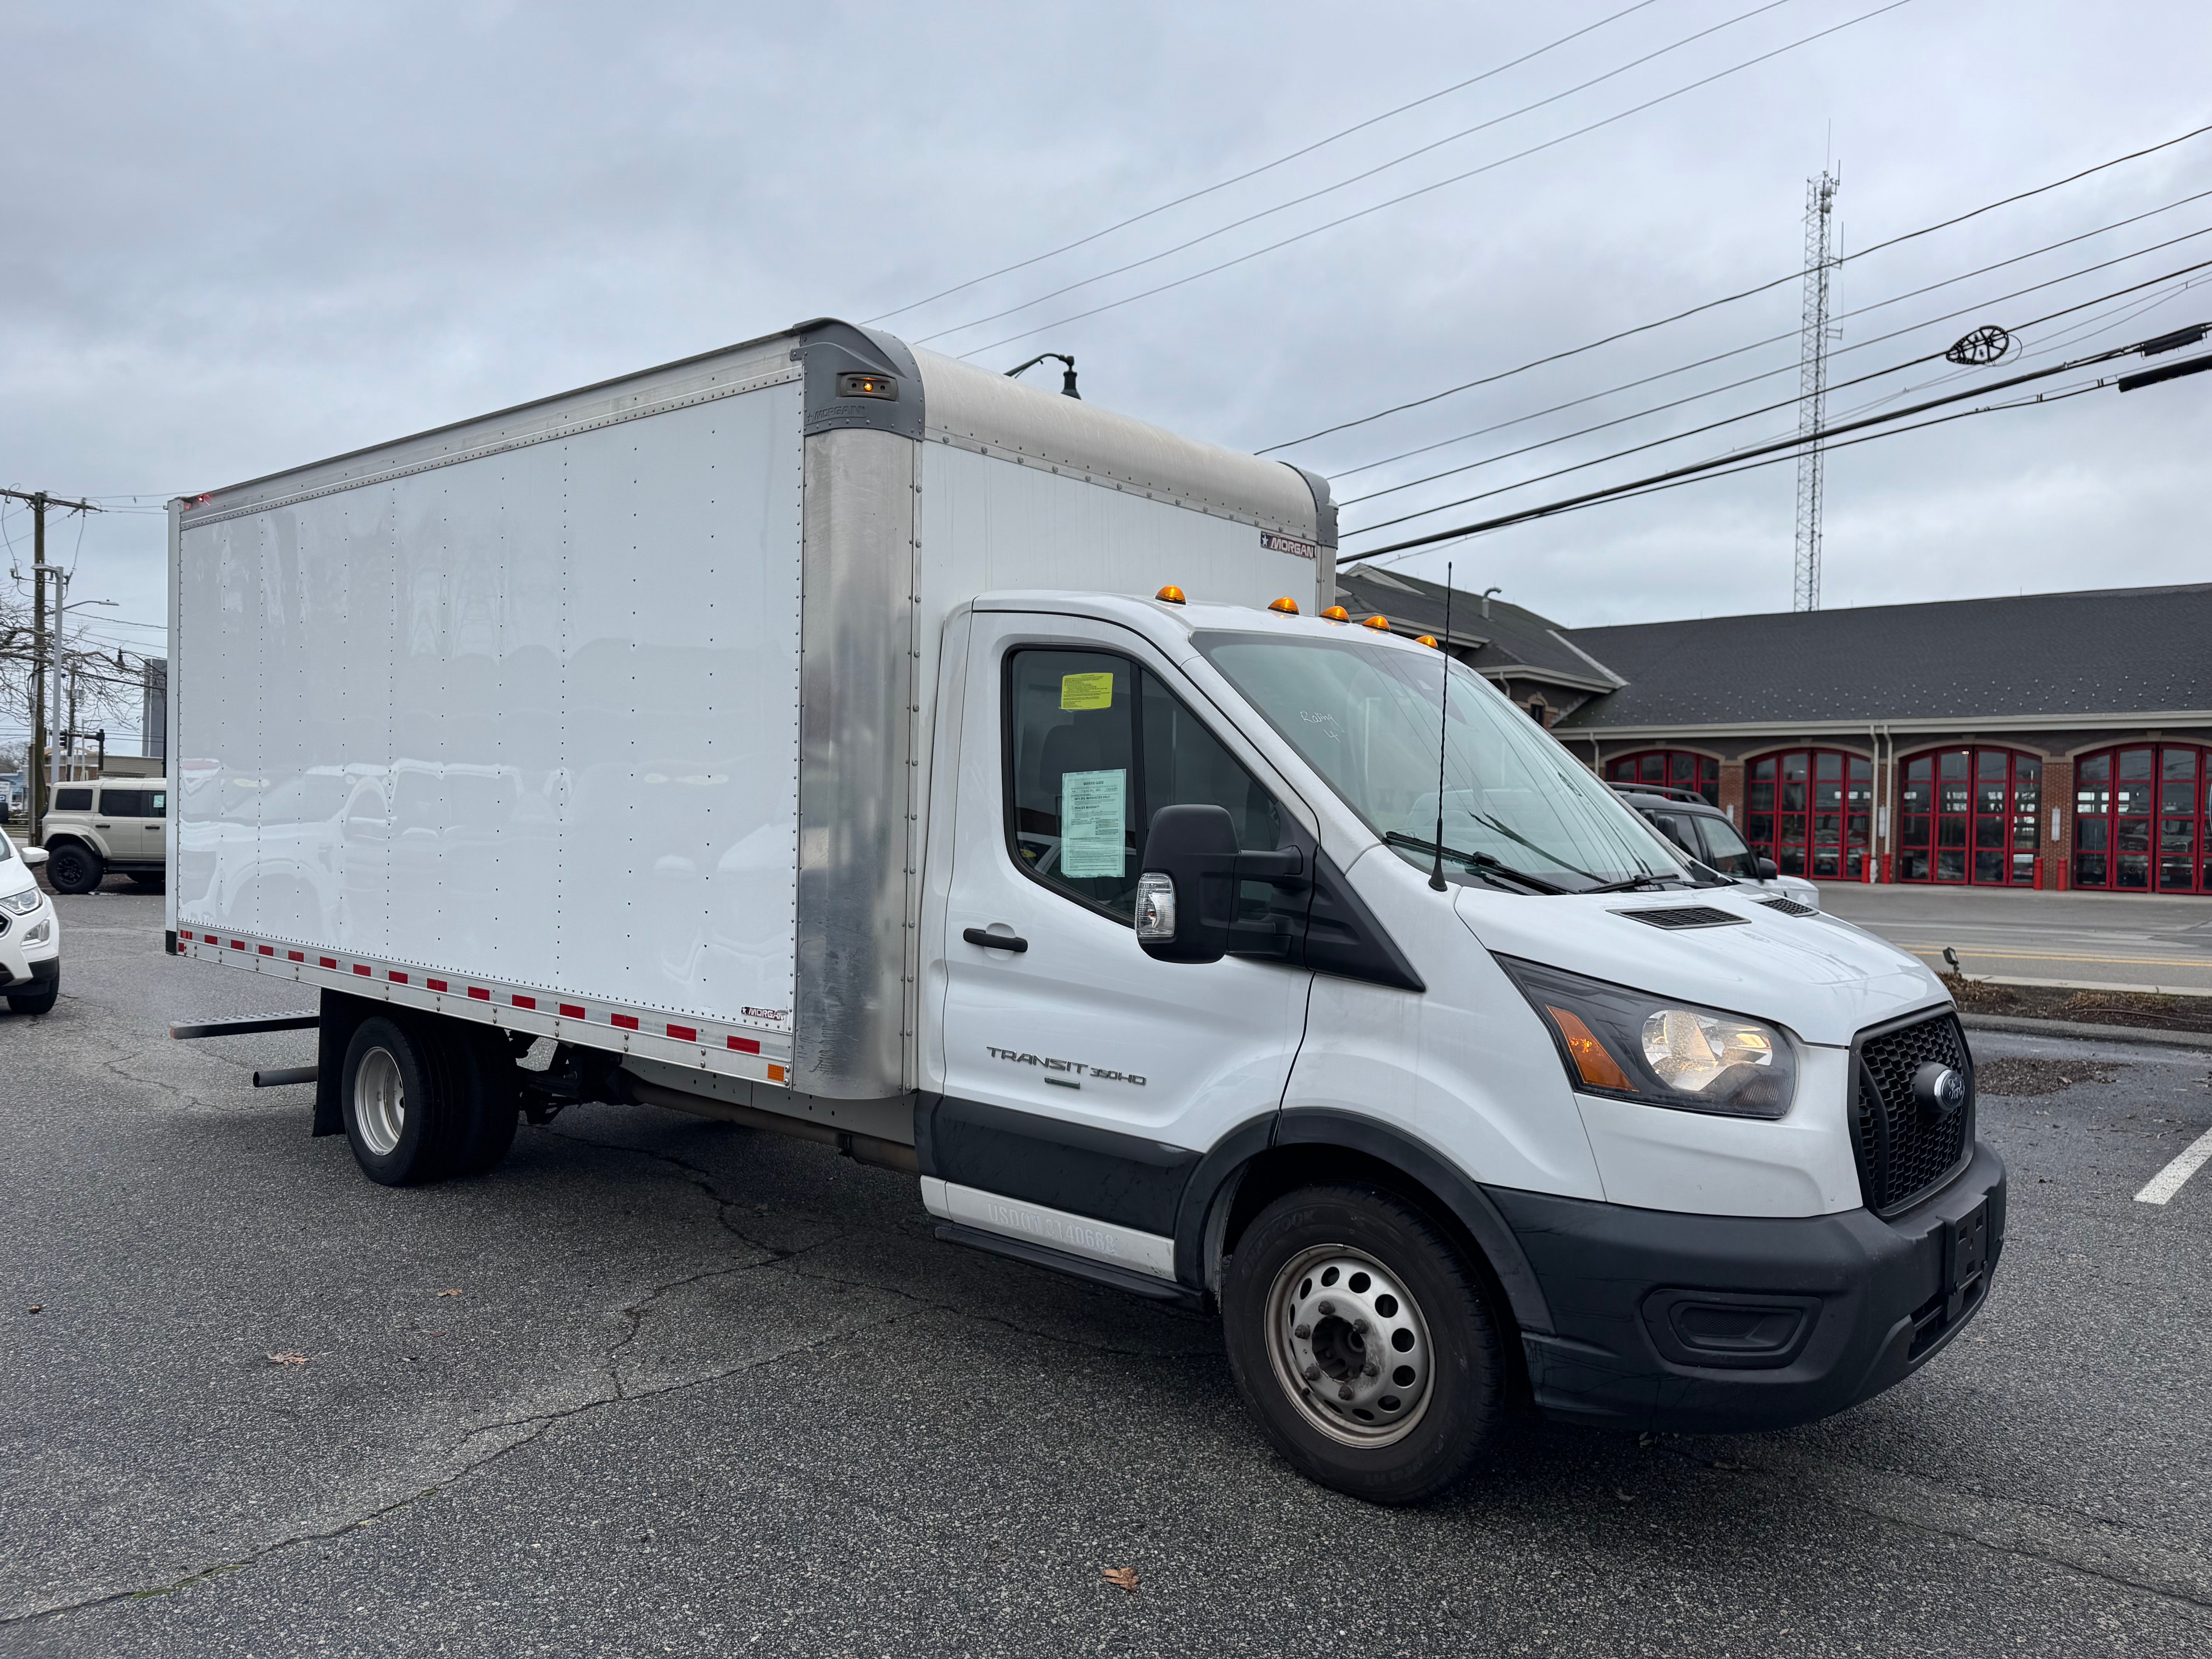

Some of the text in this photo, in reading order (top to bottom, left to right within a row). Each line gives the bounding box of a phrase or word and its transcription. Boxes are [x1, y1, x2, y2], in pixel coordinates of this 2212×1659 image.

[814, 405, 861, 420] MORGAN
[1270, 537, 1314, 558] MORGAN
[1300, 711, 1345, 733] Rating
[1324, 729, 1341, 742] 4
[749, 1008, 785, 1020] MORGAN
[987, 1046, 1088, 1073] TRANSIT
[1090, 1067, 1147, 1085] 350HD
[1948, 1077, 1963, 1099] Ford
[987, 1202, 1041, 1233] USDOT
